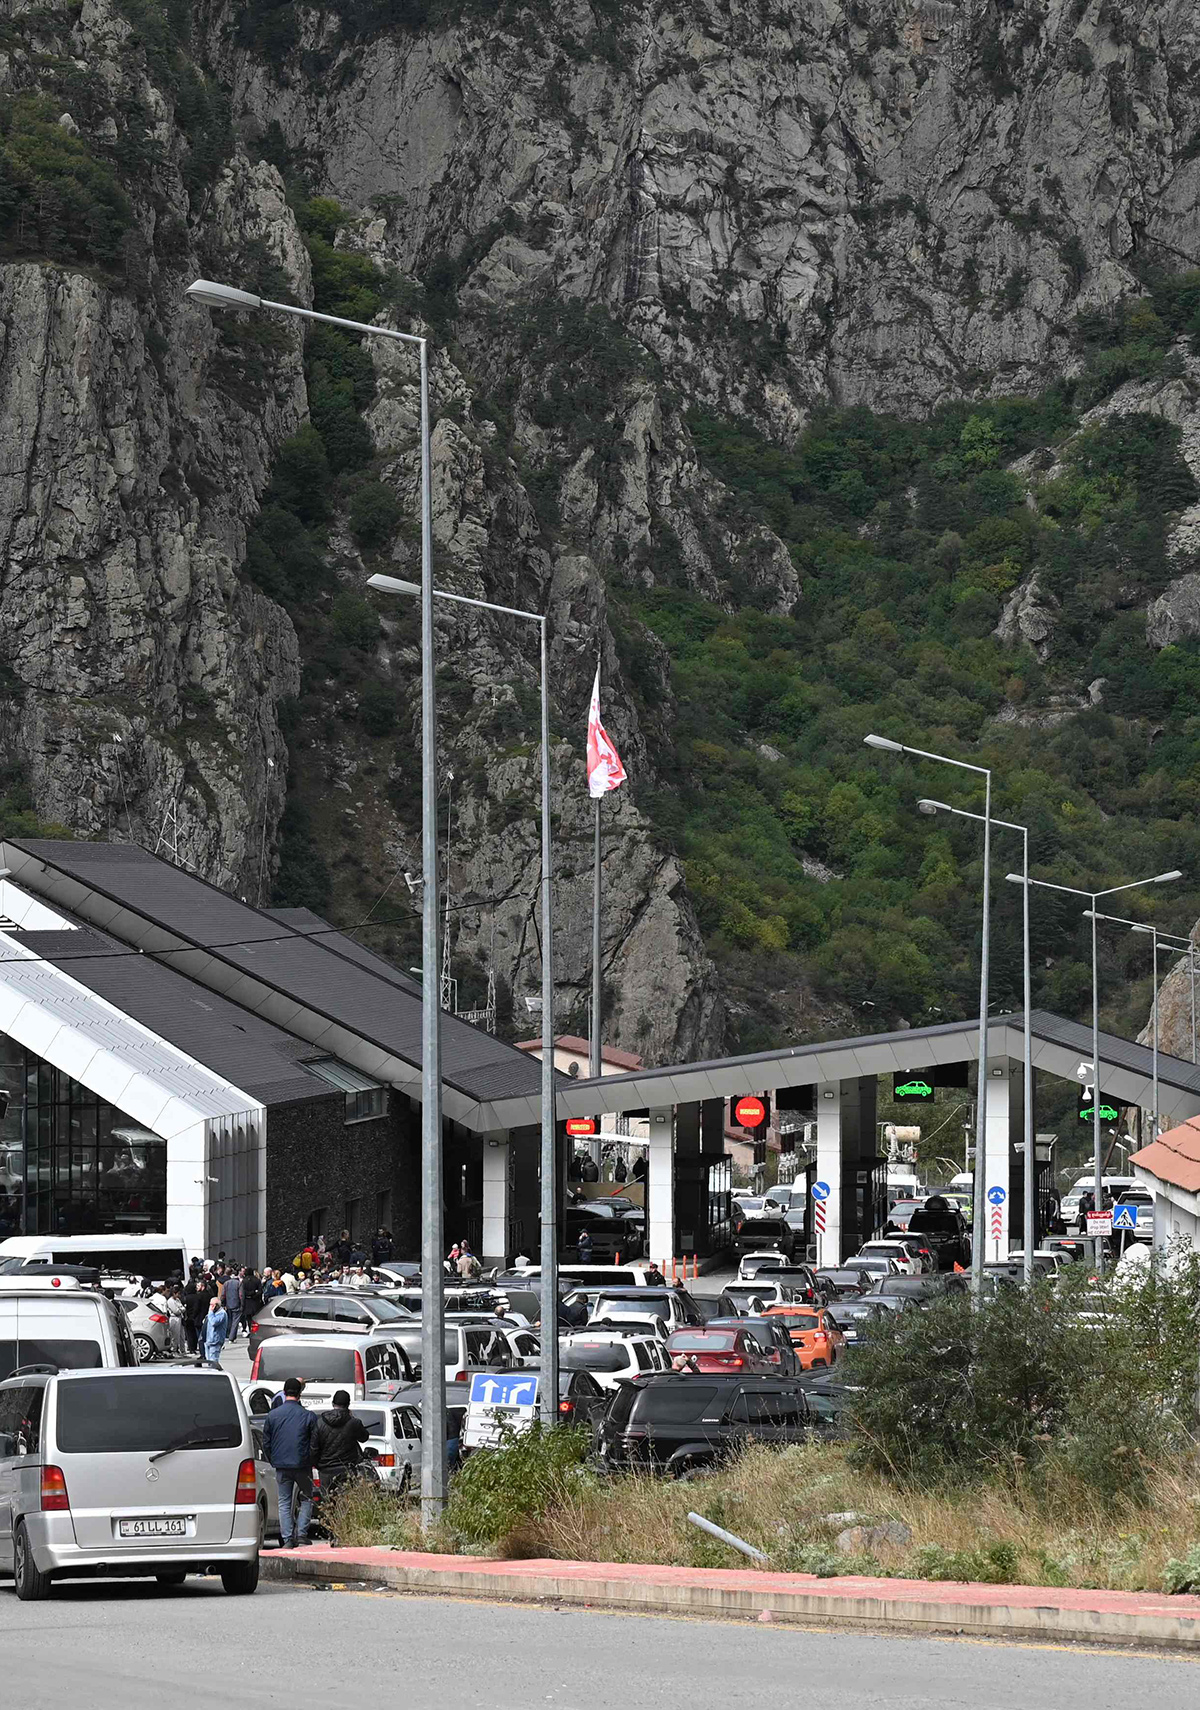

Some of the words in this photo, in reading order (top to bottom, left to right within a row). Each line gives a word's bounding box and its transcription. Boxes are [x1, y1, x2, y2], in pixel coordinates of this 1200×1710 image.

[134, 1521, 145, 1532] 61
[148, 1521, 162, 1531] LL
[165, 1521, 182, 1531] 161
